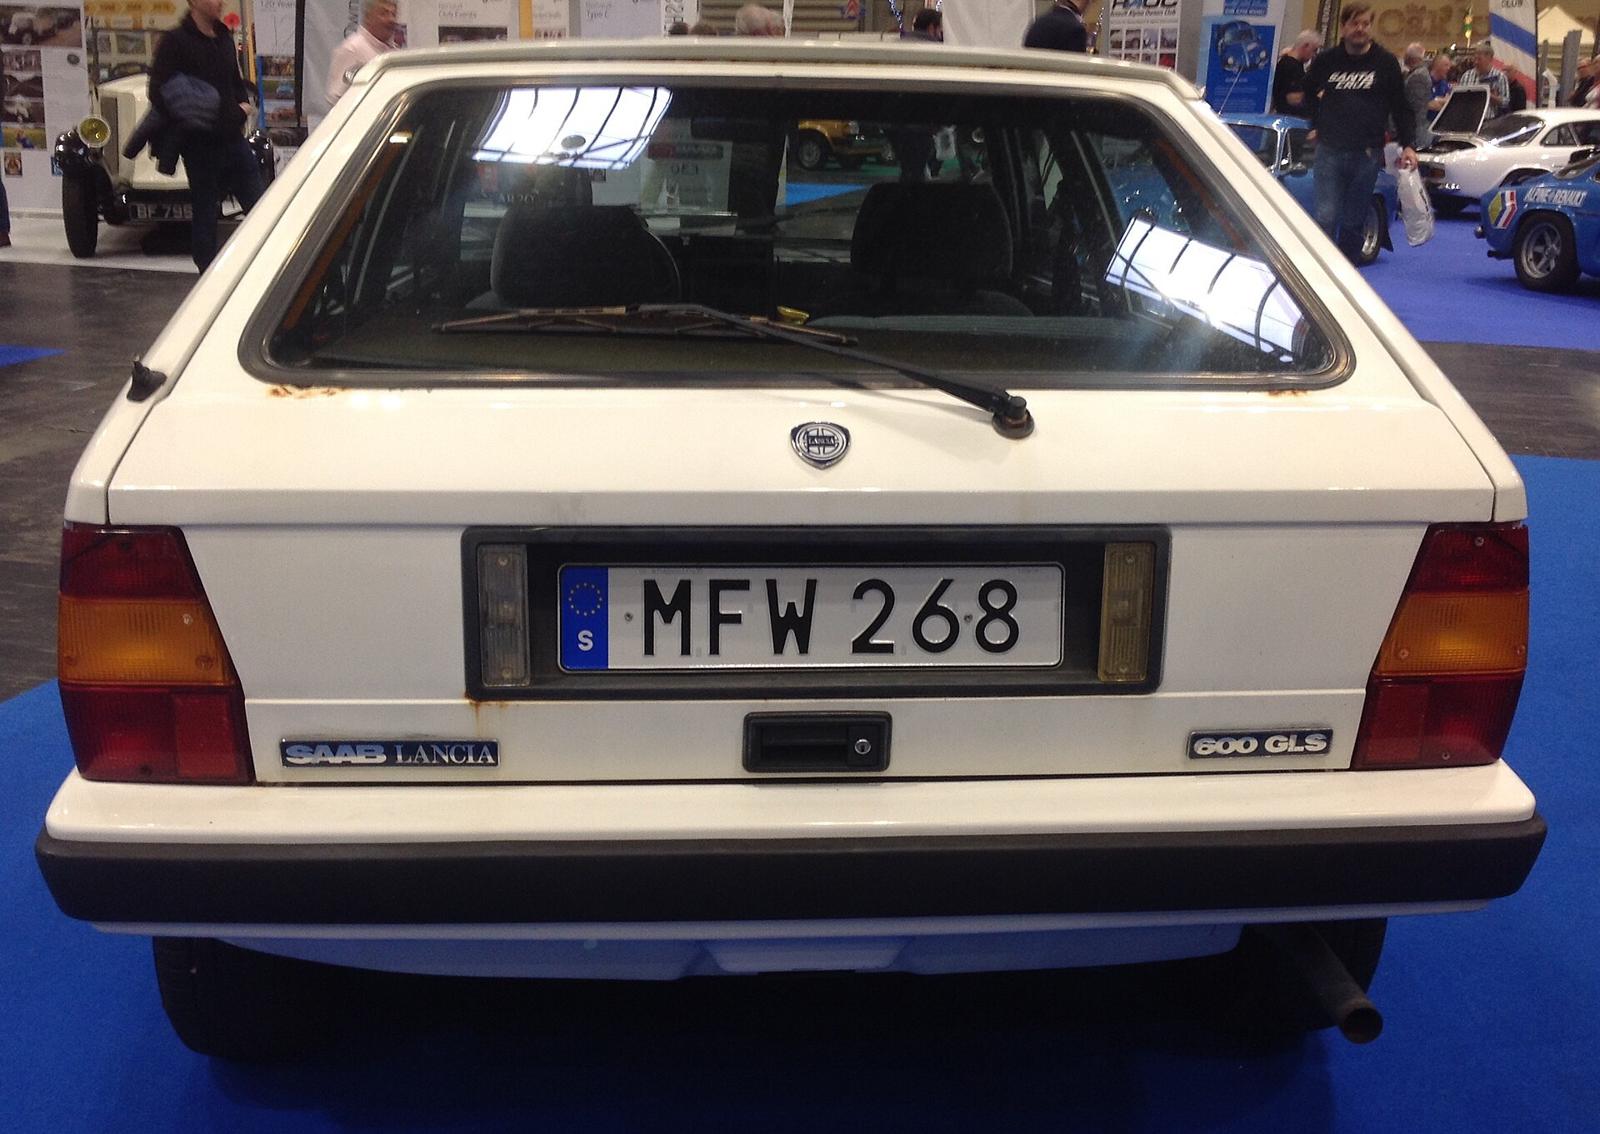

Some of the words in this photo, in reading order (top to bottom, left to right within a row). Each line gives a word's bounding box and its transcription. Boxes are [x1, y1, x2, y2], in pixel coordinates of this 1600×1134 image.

[1328, 71, 1376, 82] SANTA
[643, 578, 818, 656] MFW
[851, 578, 1020, 655] 268
[577, 629, 594, 651] S
[285, 744, 387, 764] SAAB
[394, 744, 496, 764] LANCIA
[1193, 736, 1259, 756] 600
[1264, 733, 1328, 754] GLS
